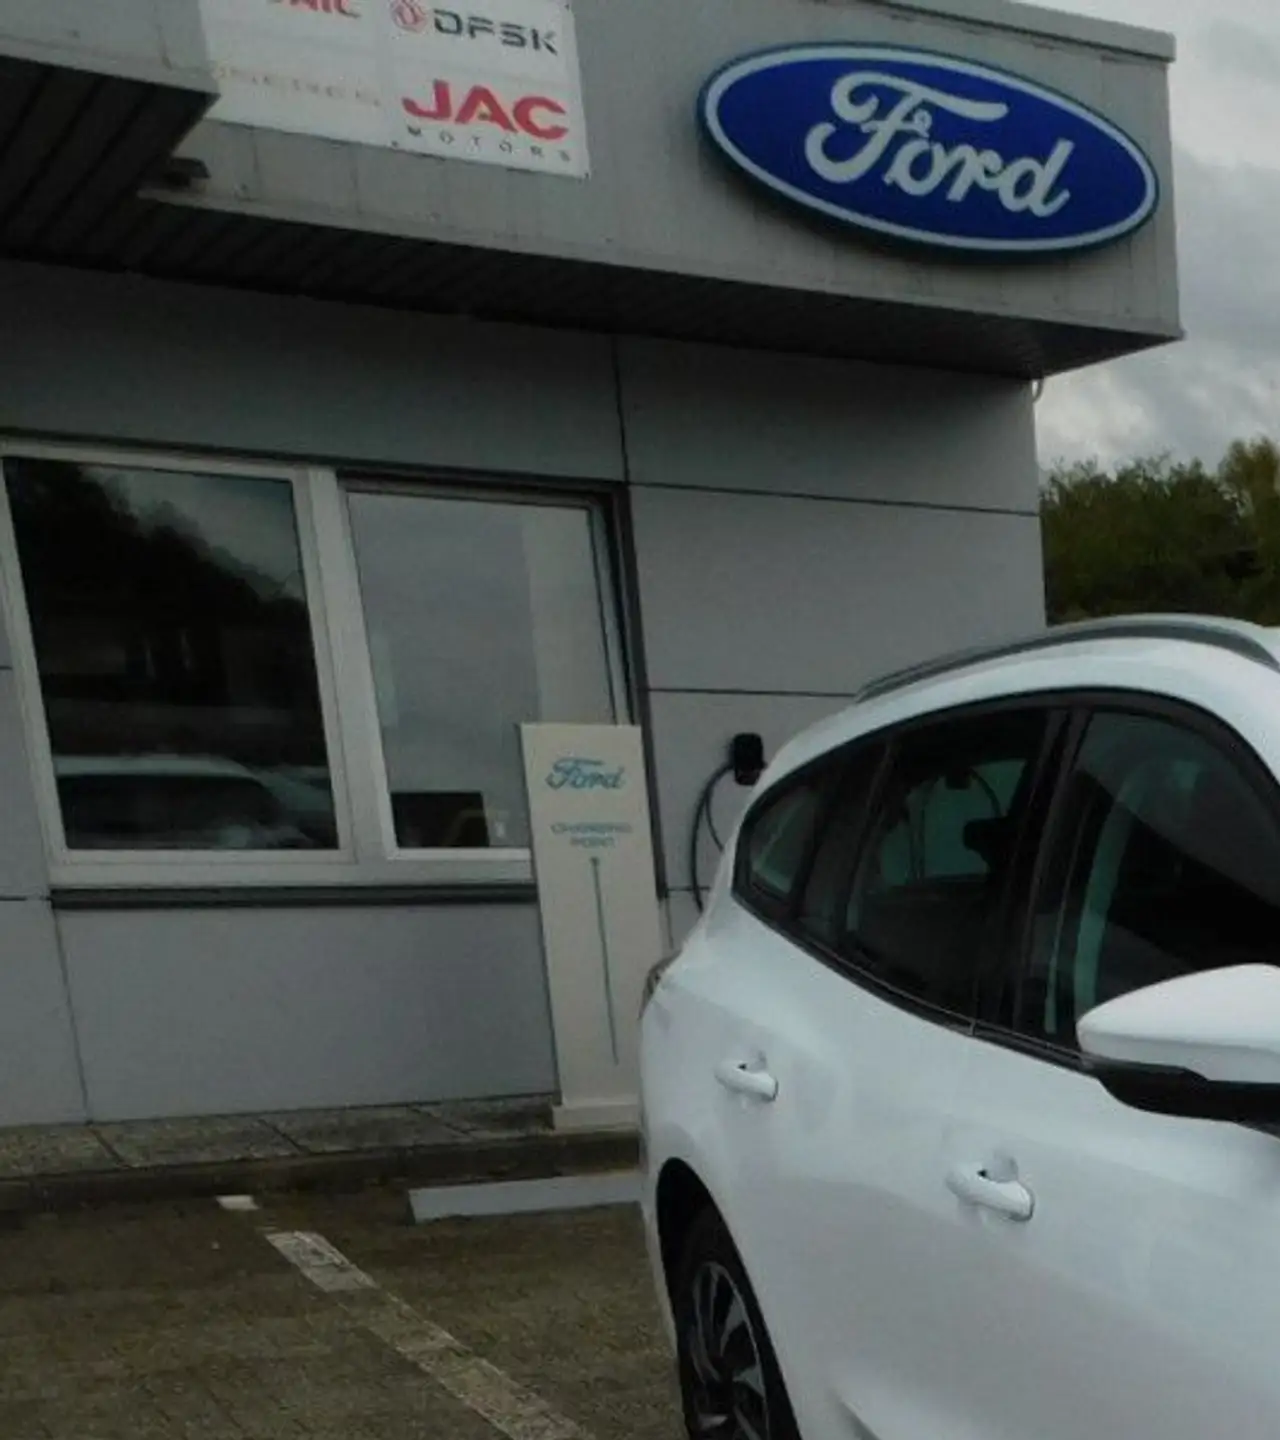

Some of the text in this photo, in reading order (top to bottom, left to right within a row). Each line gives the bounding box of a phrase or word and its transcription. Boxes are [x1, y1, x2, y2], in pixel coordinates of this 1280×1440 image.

[433, 8, 558, 56] DFSK
[402, 79, 569, 140] JAC
[804, 71, 1071, 218] Ford
[545, 756, 626, 791] Ford
